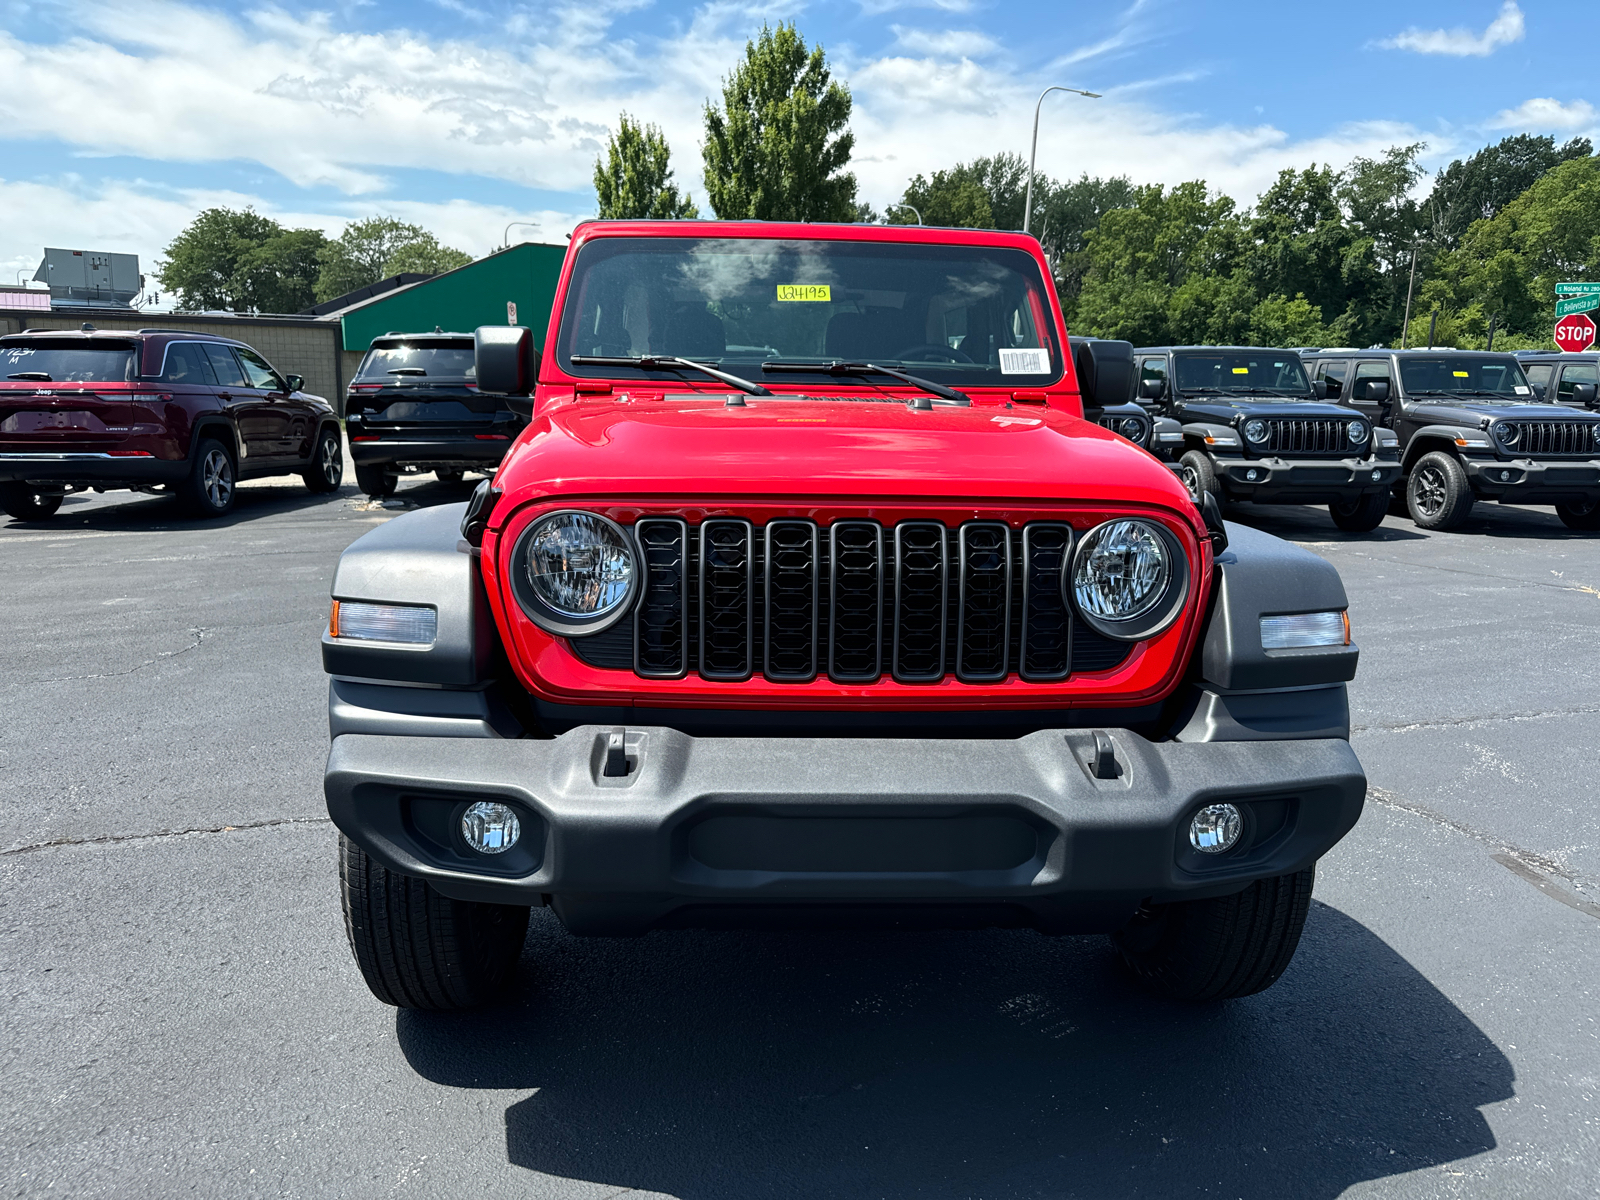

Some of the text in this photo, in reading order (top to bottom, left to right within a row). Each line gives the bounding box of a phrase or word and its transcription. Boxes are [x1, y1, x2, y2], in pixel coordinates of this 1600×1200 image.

[779, 286, 826, 299] J24195
[1563, 300, 1586, 312] Bellevista
[1557, 326, 1592, 341] STOP
